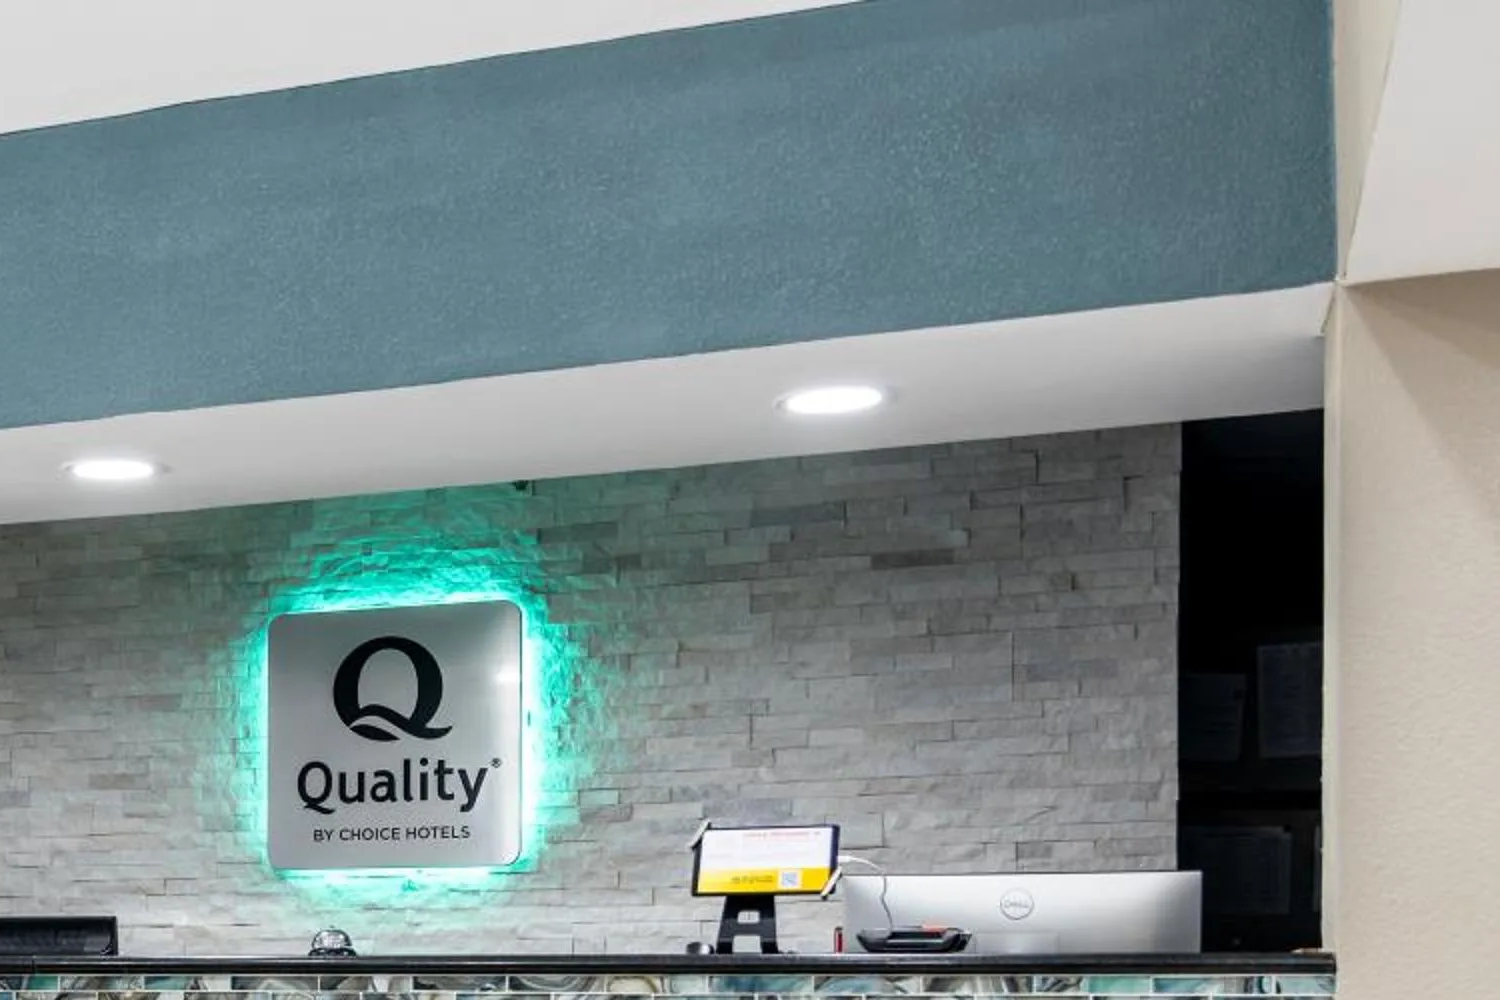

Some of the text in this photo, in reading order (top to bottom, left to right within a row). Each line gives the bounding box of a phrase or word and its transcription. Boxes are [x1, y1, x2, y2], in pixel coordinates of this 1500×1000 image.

[333, 635, 453, 742] Q
[313, 825, 471, 842] BY CHOICE HOTELS
